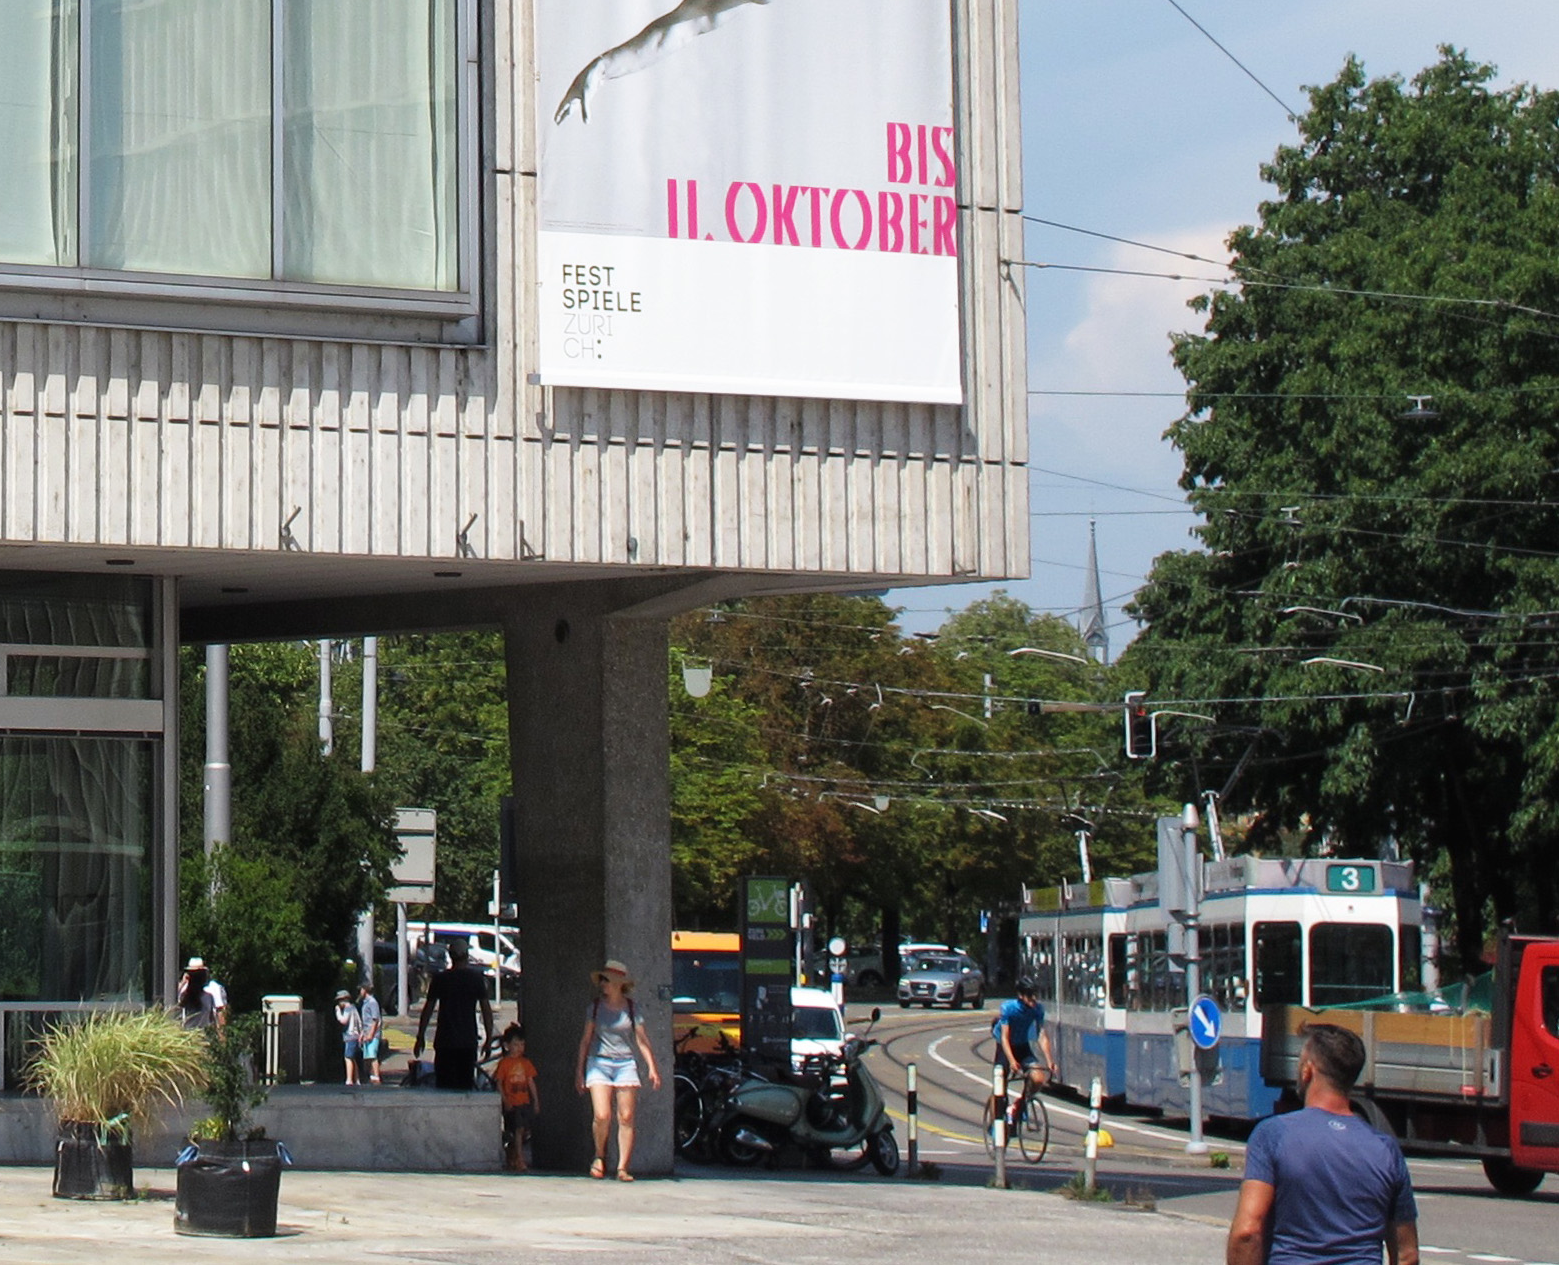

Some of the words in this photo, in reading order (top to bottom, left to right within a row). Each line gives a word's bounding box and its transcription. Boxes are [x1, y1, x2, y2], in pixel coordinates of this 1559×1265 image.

[886, 121, 956, 188] BIS
[724, 181, 958, 258] OKTOBER
[562, 263, 615, 287] FEST
[562, 288, 642, 312] SPIELE
[563, 312, 613, 336] ZÜRI
[1341, 867, 1359, 890] 3
